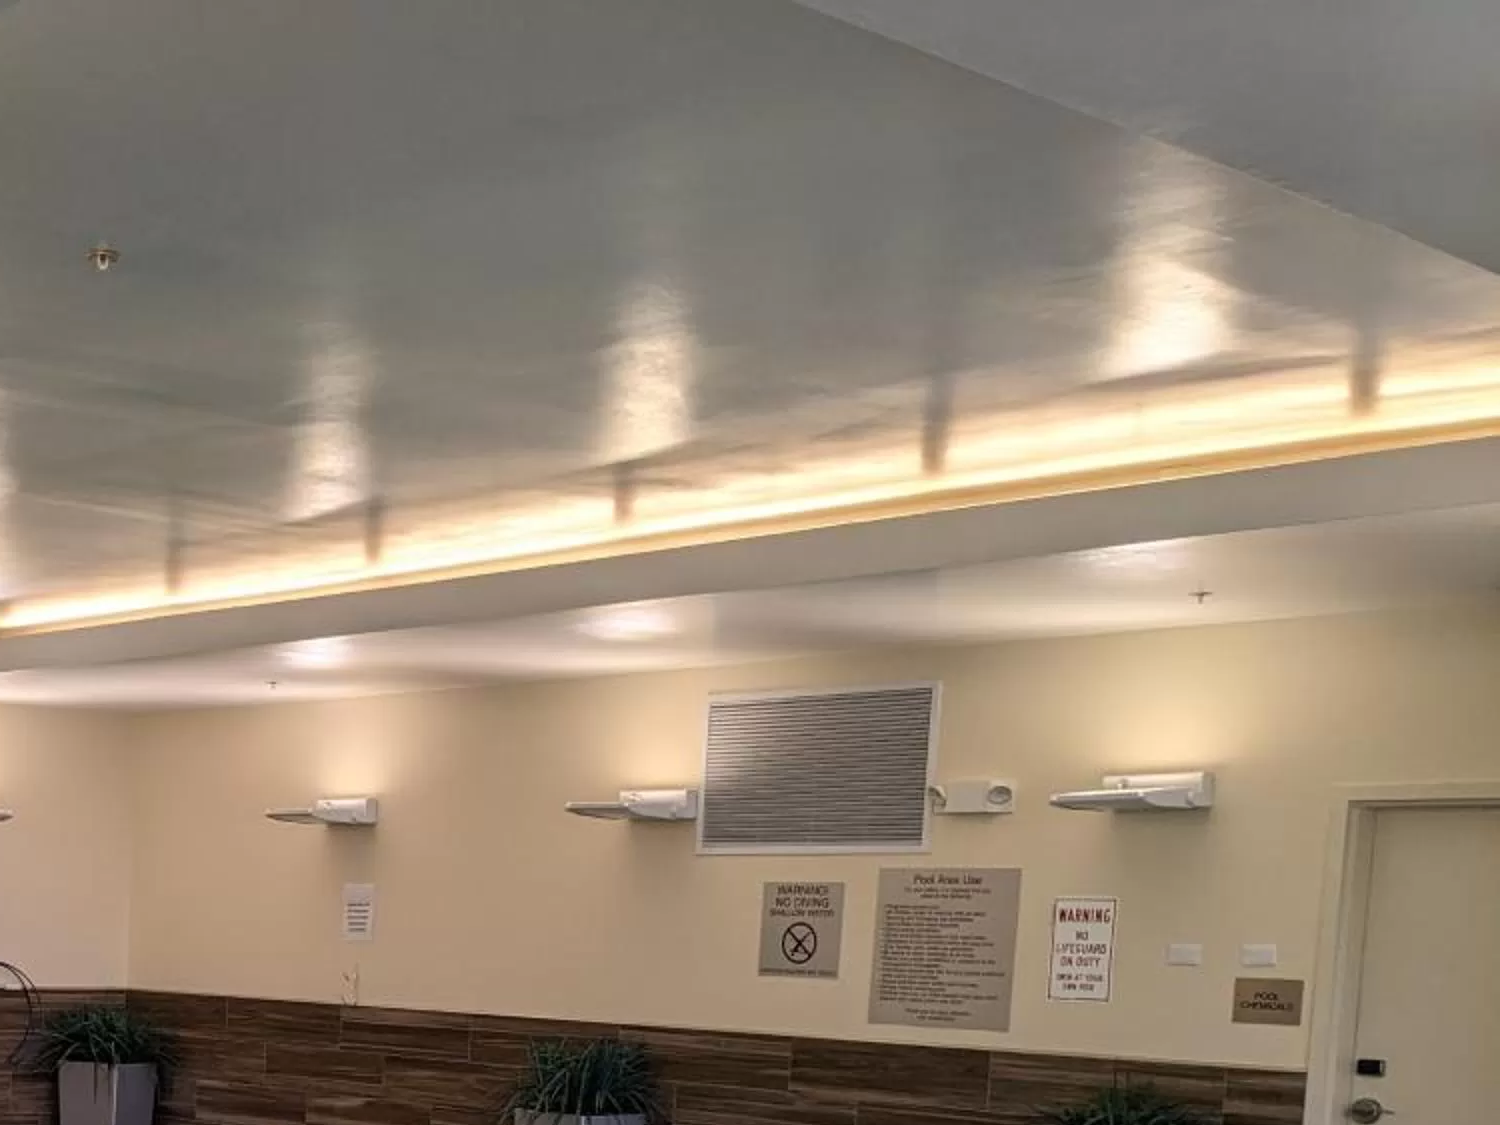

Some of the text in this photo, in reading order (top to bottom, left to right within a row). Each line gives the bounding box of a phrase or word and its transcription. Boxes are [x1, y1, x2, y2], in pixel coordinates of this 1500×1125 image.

[775, 897, 791, 907] NO
[1059, 908, 1111, 923] WARNING
[1076, 931, 1089, 941] NO
[1060, 956, 1101, 967] ON DUTY
[1253, 992, 1279, 1001] POOL
